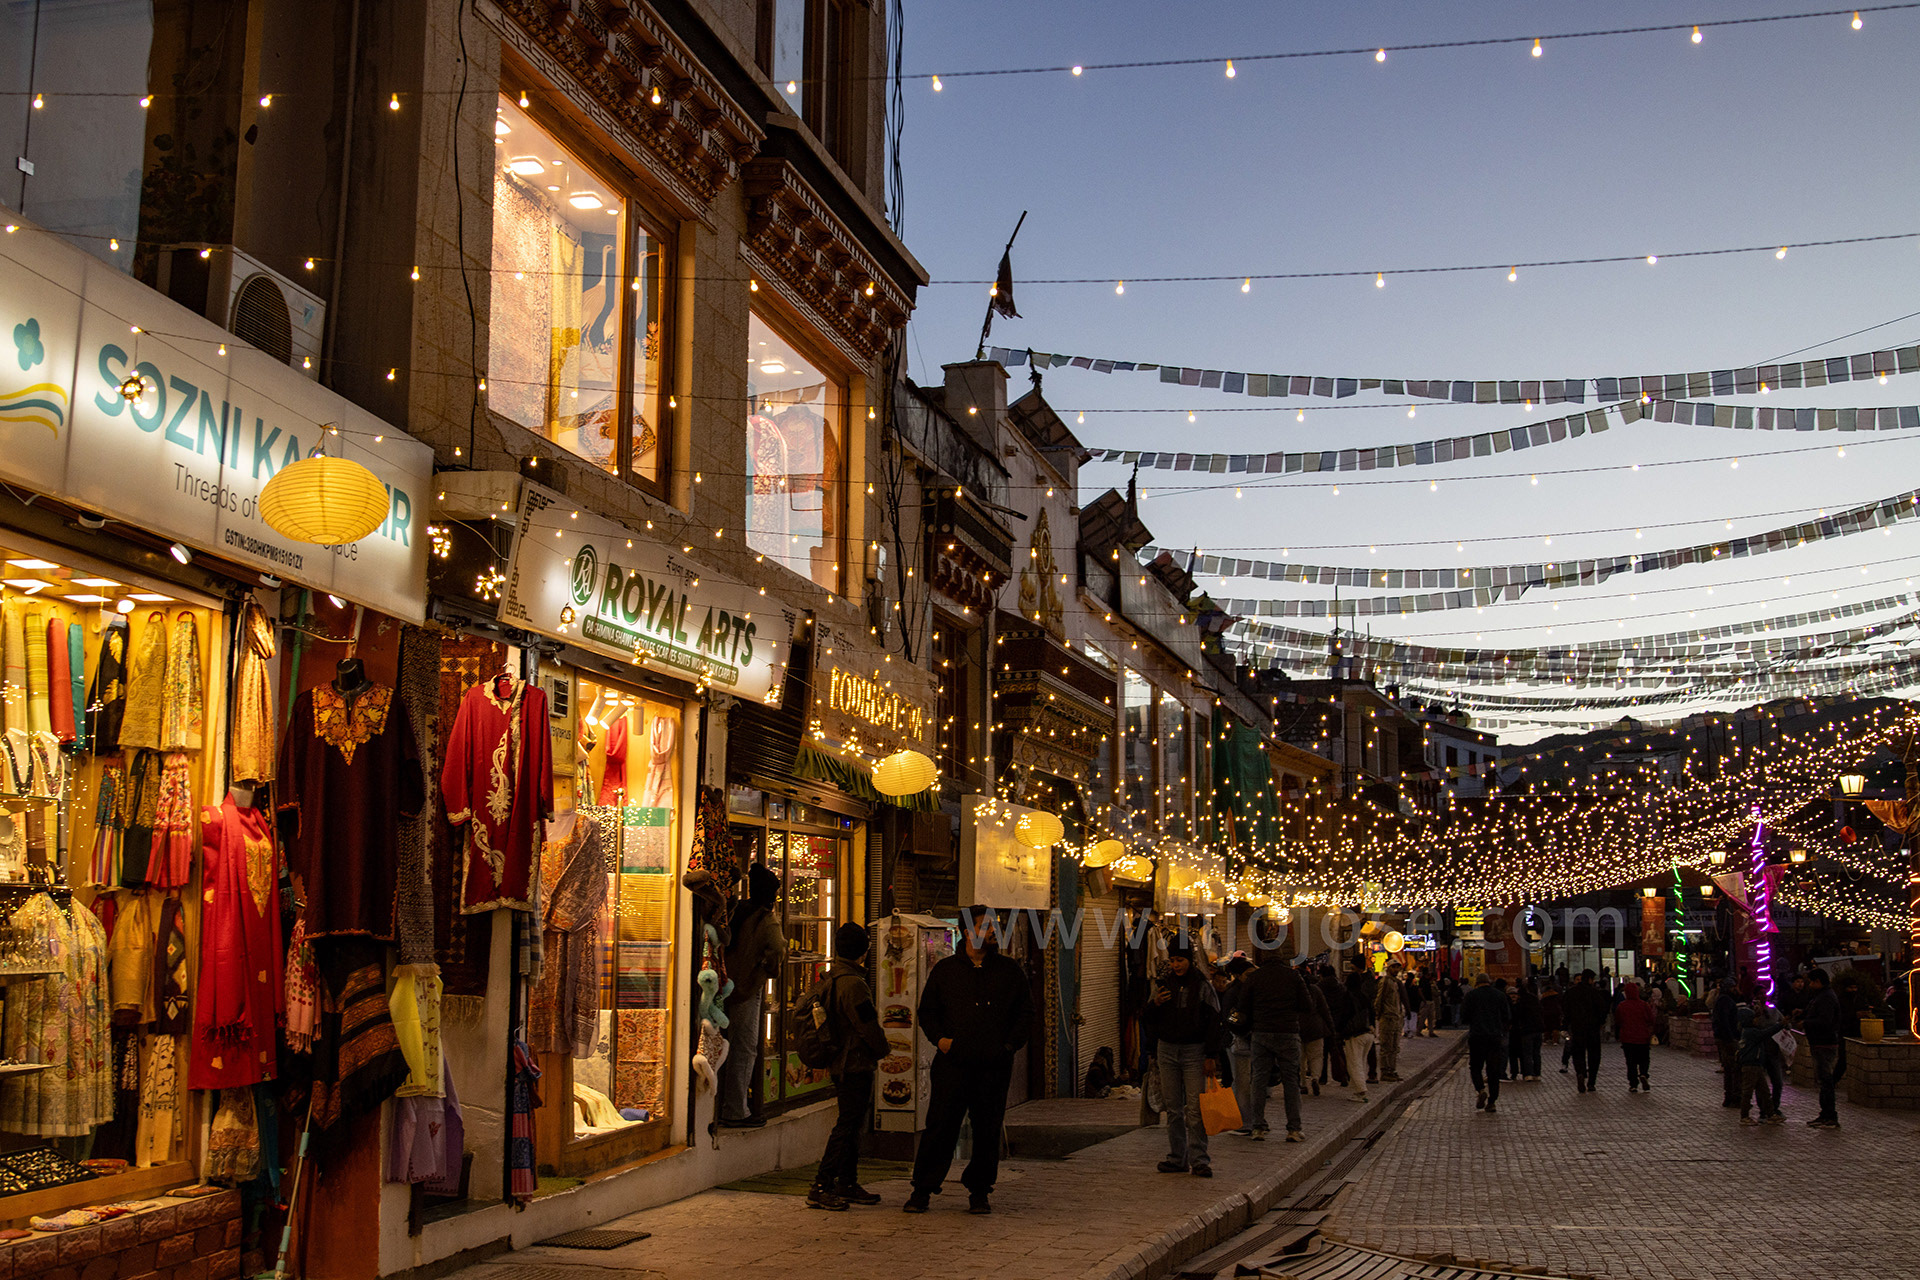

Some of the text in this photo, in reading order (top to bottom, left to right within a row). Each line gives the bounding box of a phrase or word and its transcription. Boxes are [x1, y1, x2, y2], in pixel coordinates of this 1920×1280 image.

[94, 343, 410, 548] SOZNI KAIR
[174, 462, 238, 513] Threads
[241, 495, 258, 521] of
[601, 563, 688, 645] ROYAL
[695, 605, 757, 667] ARTS
